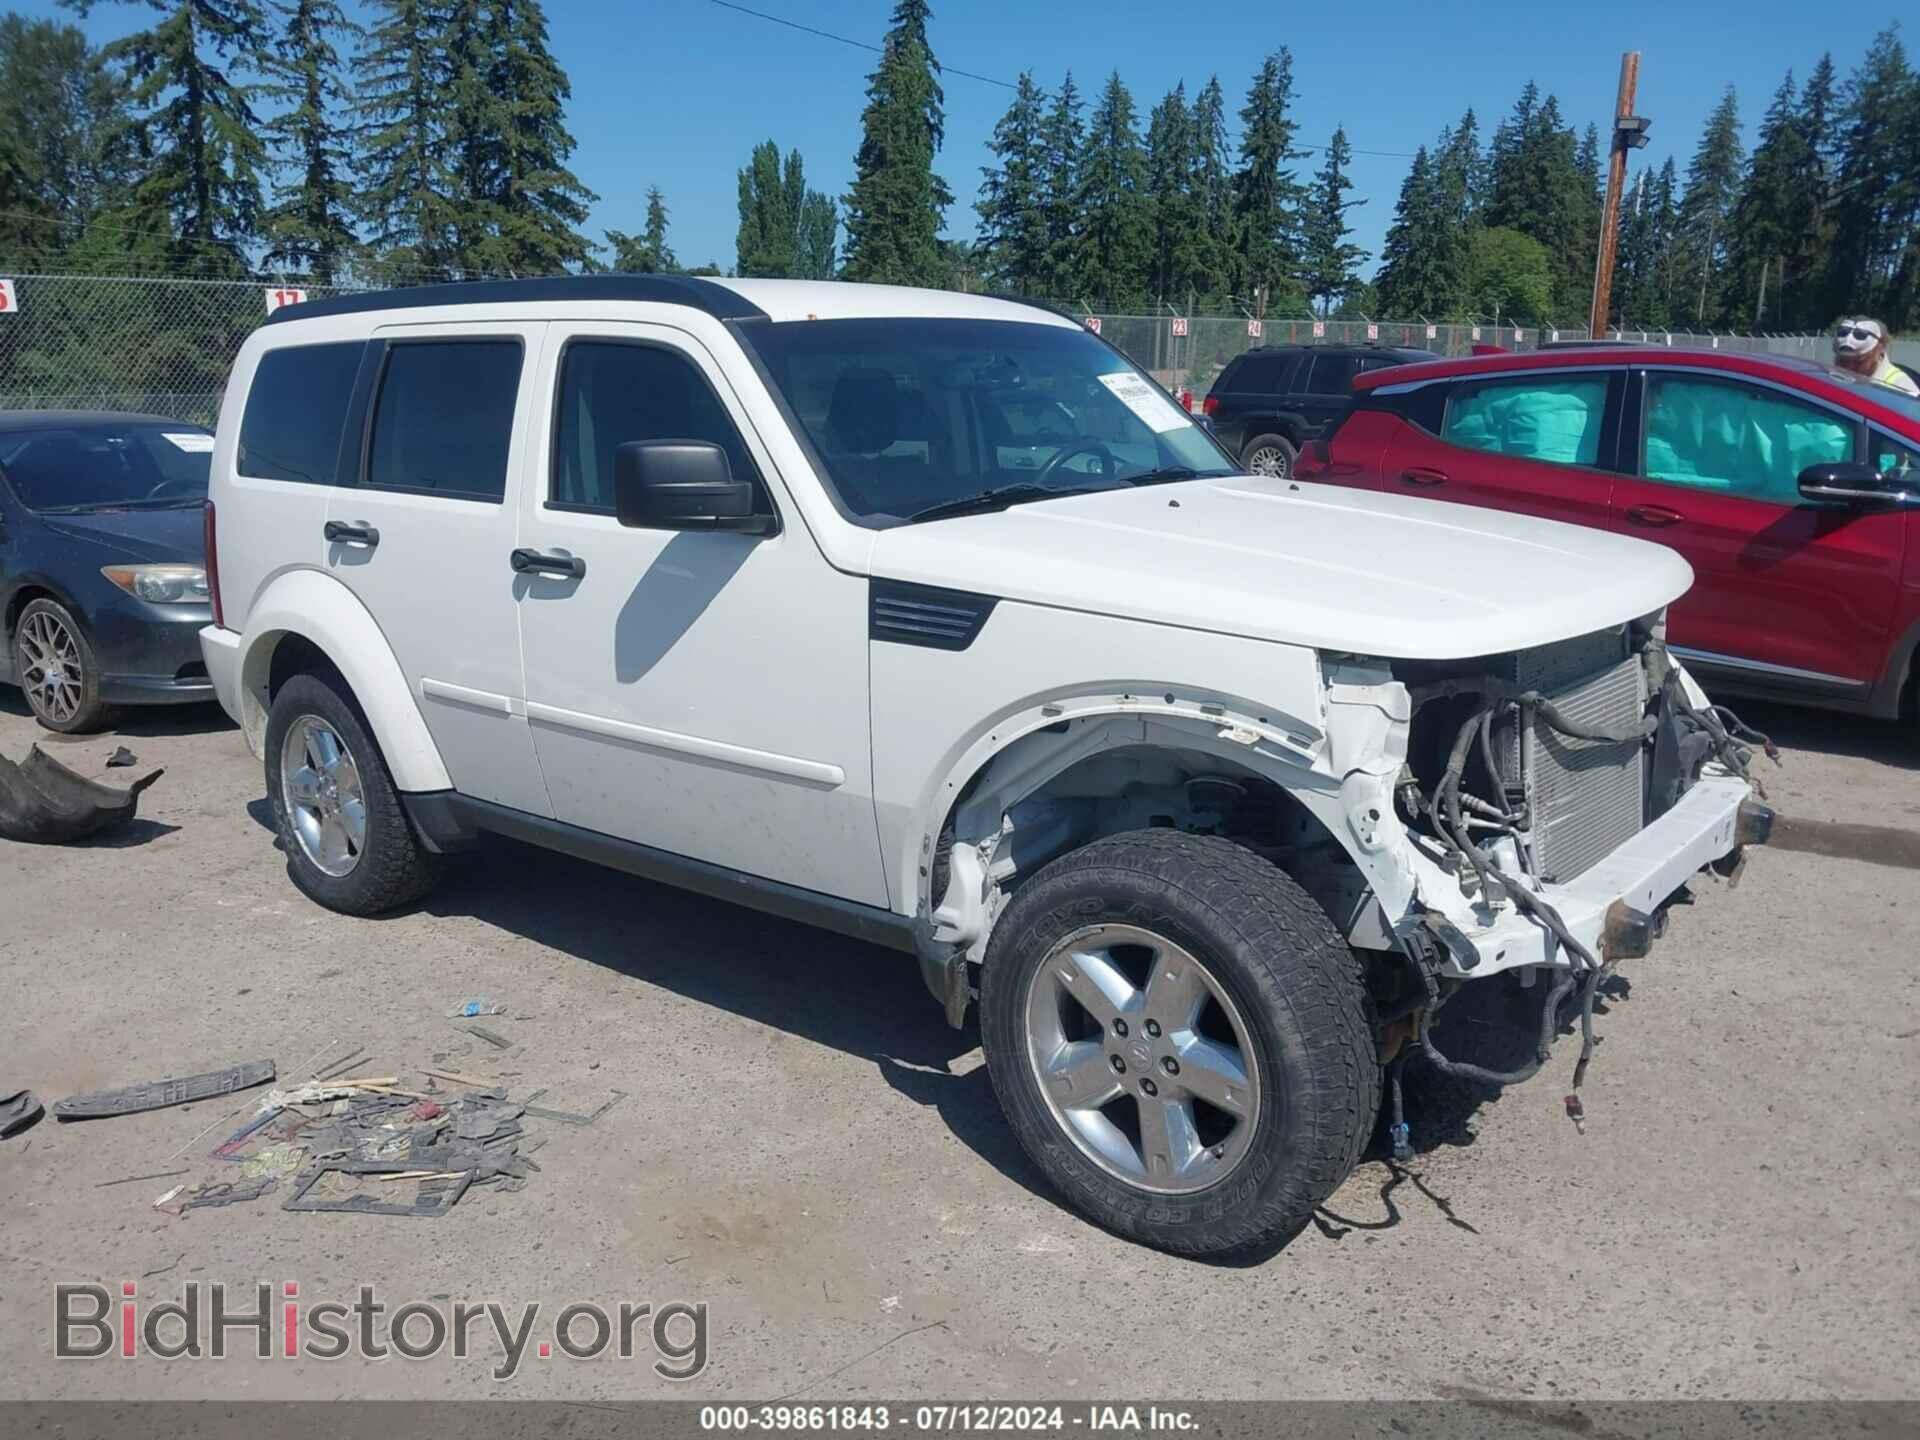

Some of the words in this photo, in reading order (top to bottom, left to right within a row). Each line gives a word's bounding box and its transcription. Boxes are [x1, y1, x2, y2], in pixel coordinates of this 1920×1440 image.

[275, 290, 298, 306] 17
[1174, 320, 1186, 335] 23
[1248, 320, 1260, 336] 24
